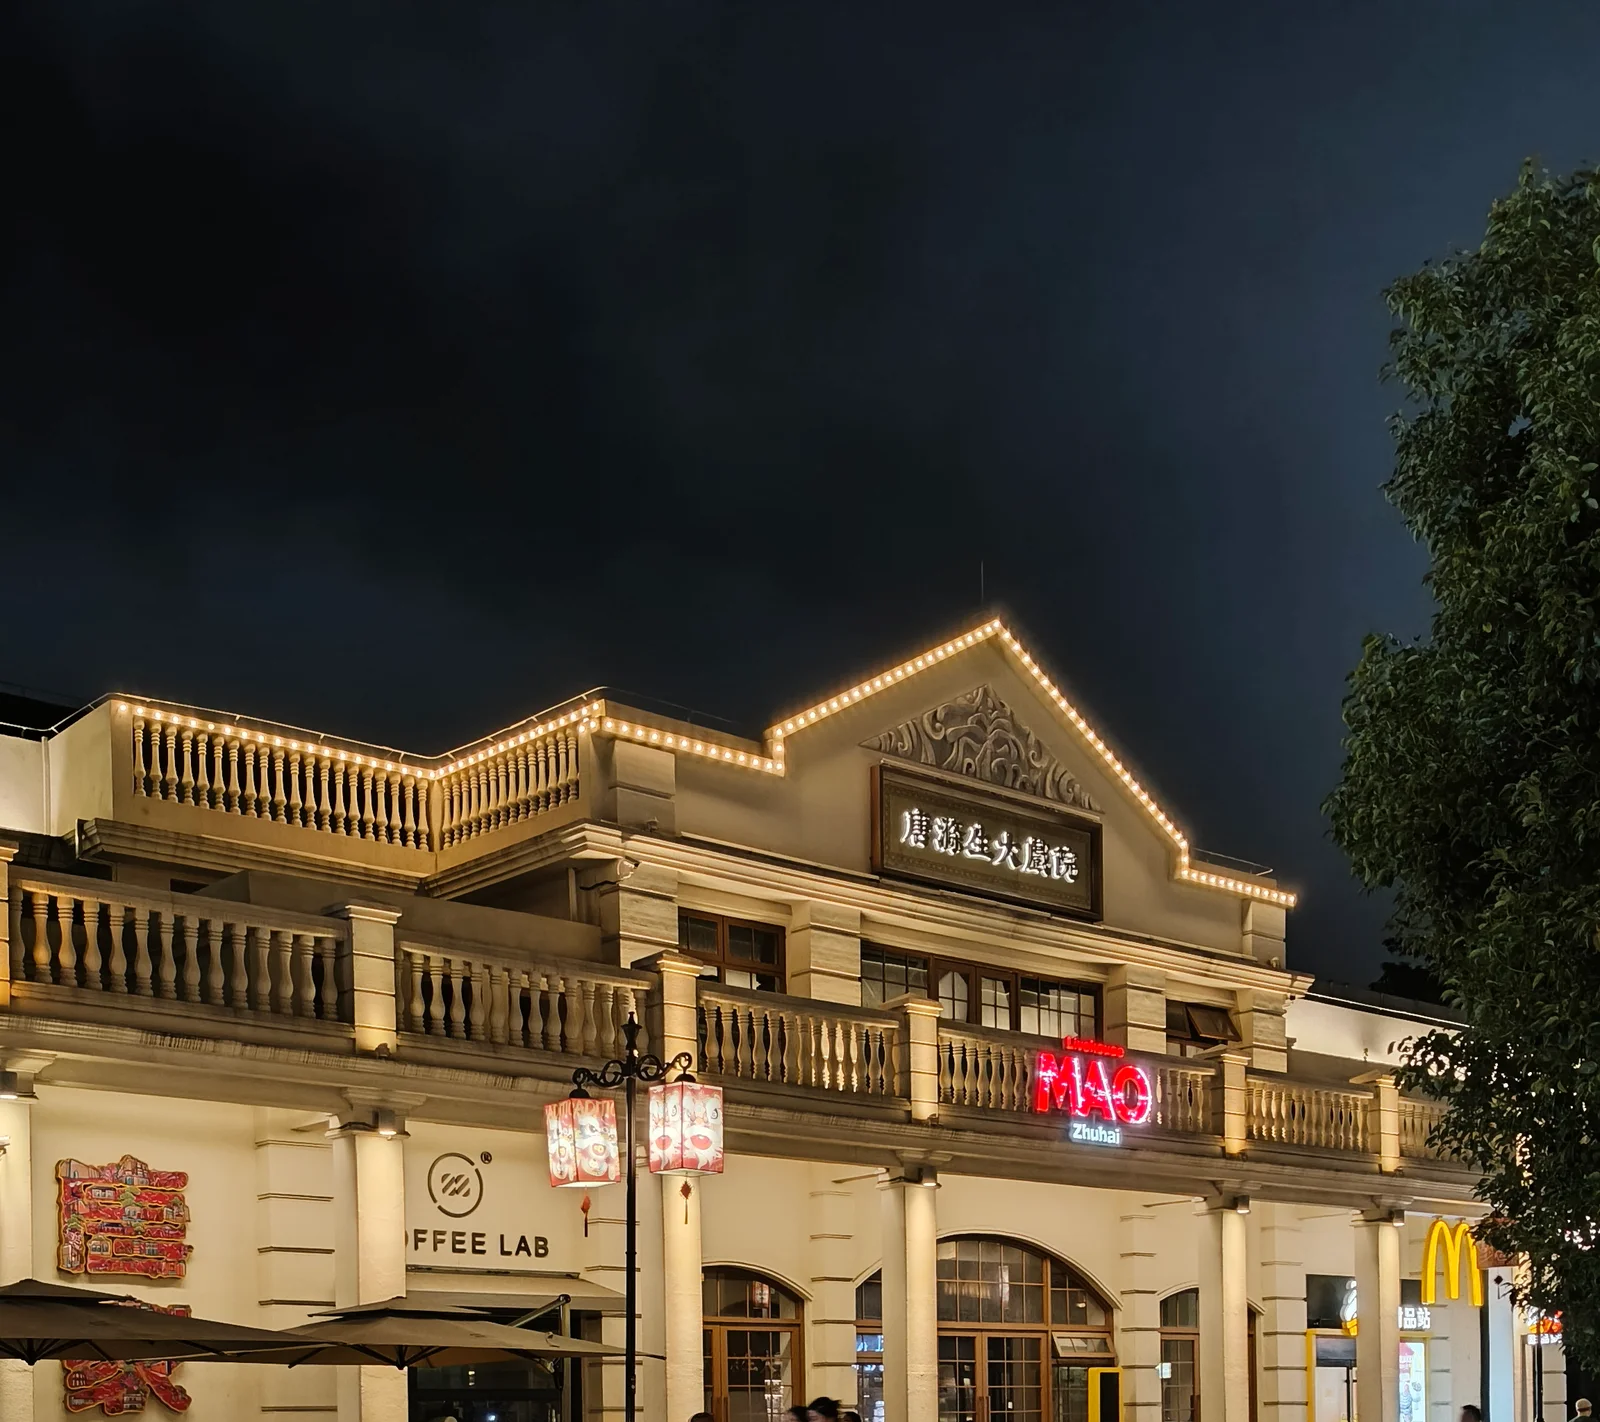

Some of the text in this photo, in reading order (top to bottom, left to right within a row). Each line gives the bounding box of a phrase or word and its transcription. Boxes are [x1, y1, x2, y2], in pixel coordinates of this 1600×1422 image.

[1035, 1052, 1153, 1124] MAO
[1072, 1123, 1121, 1145] Zhuhai
[405, 1228, 550, 1258] FFEE LAB
